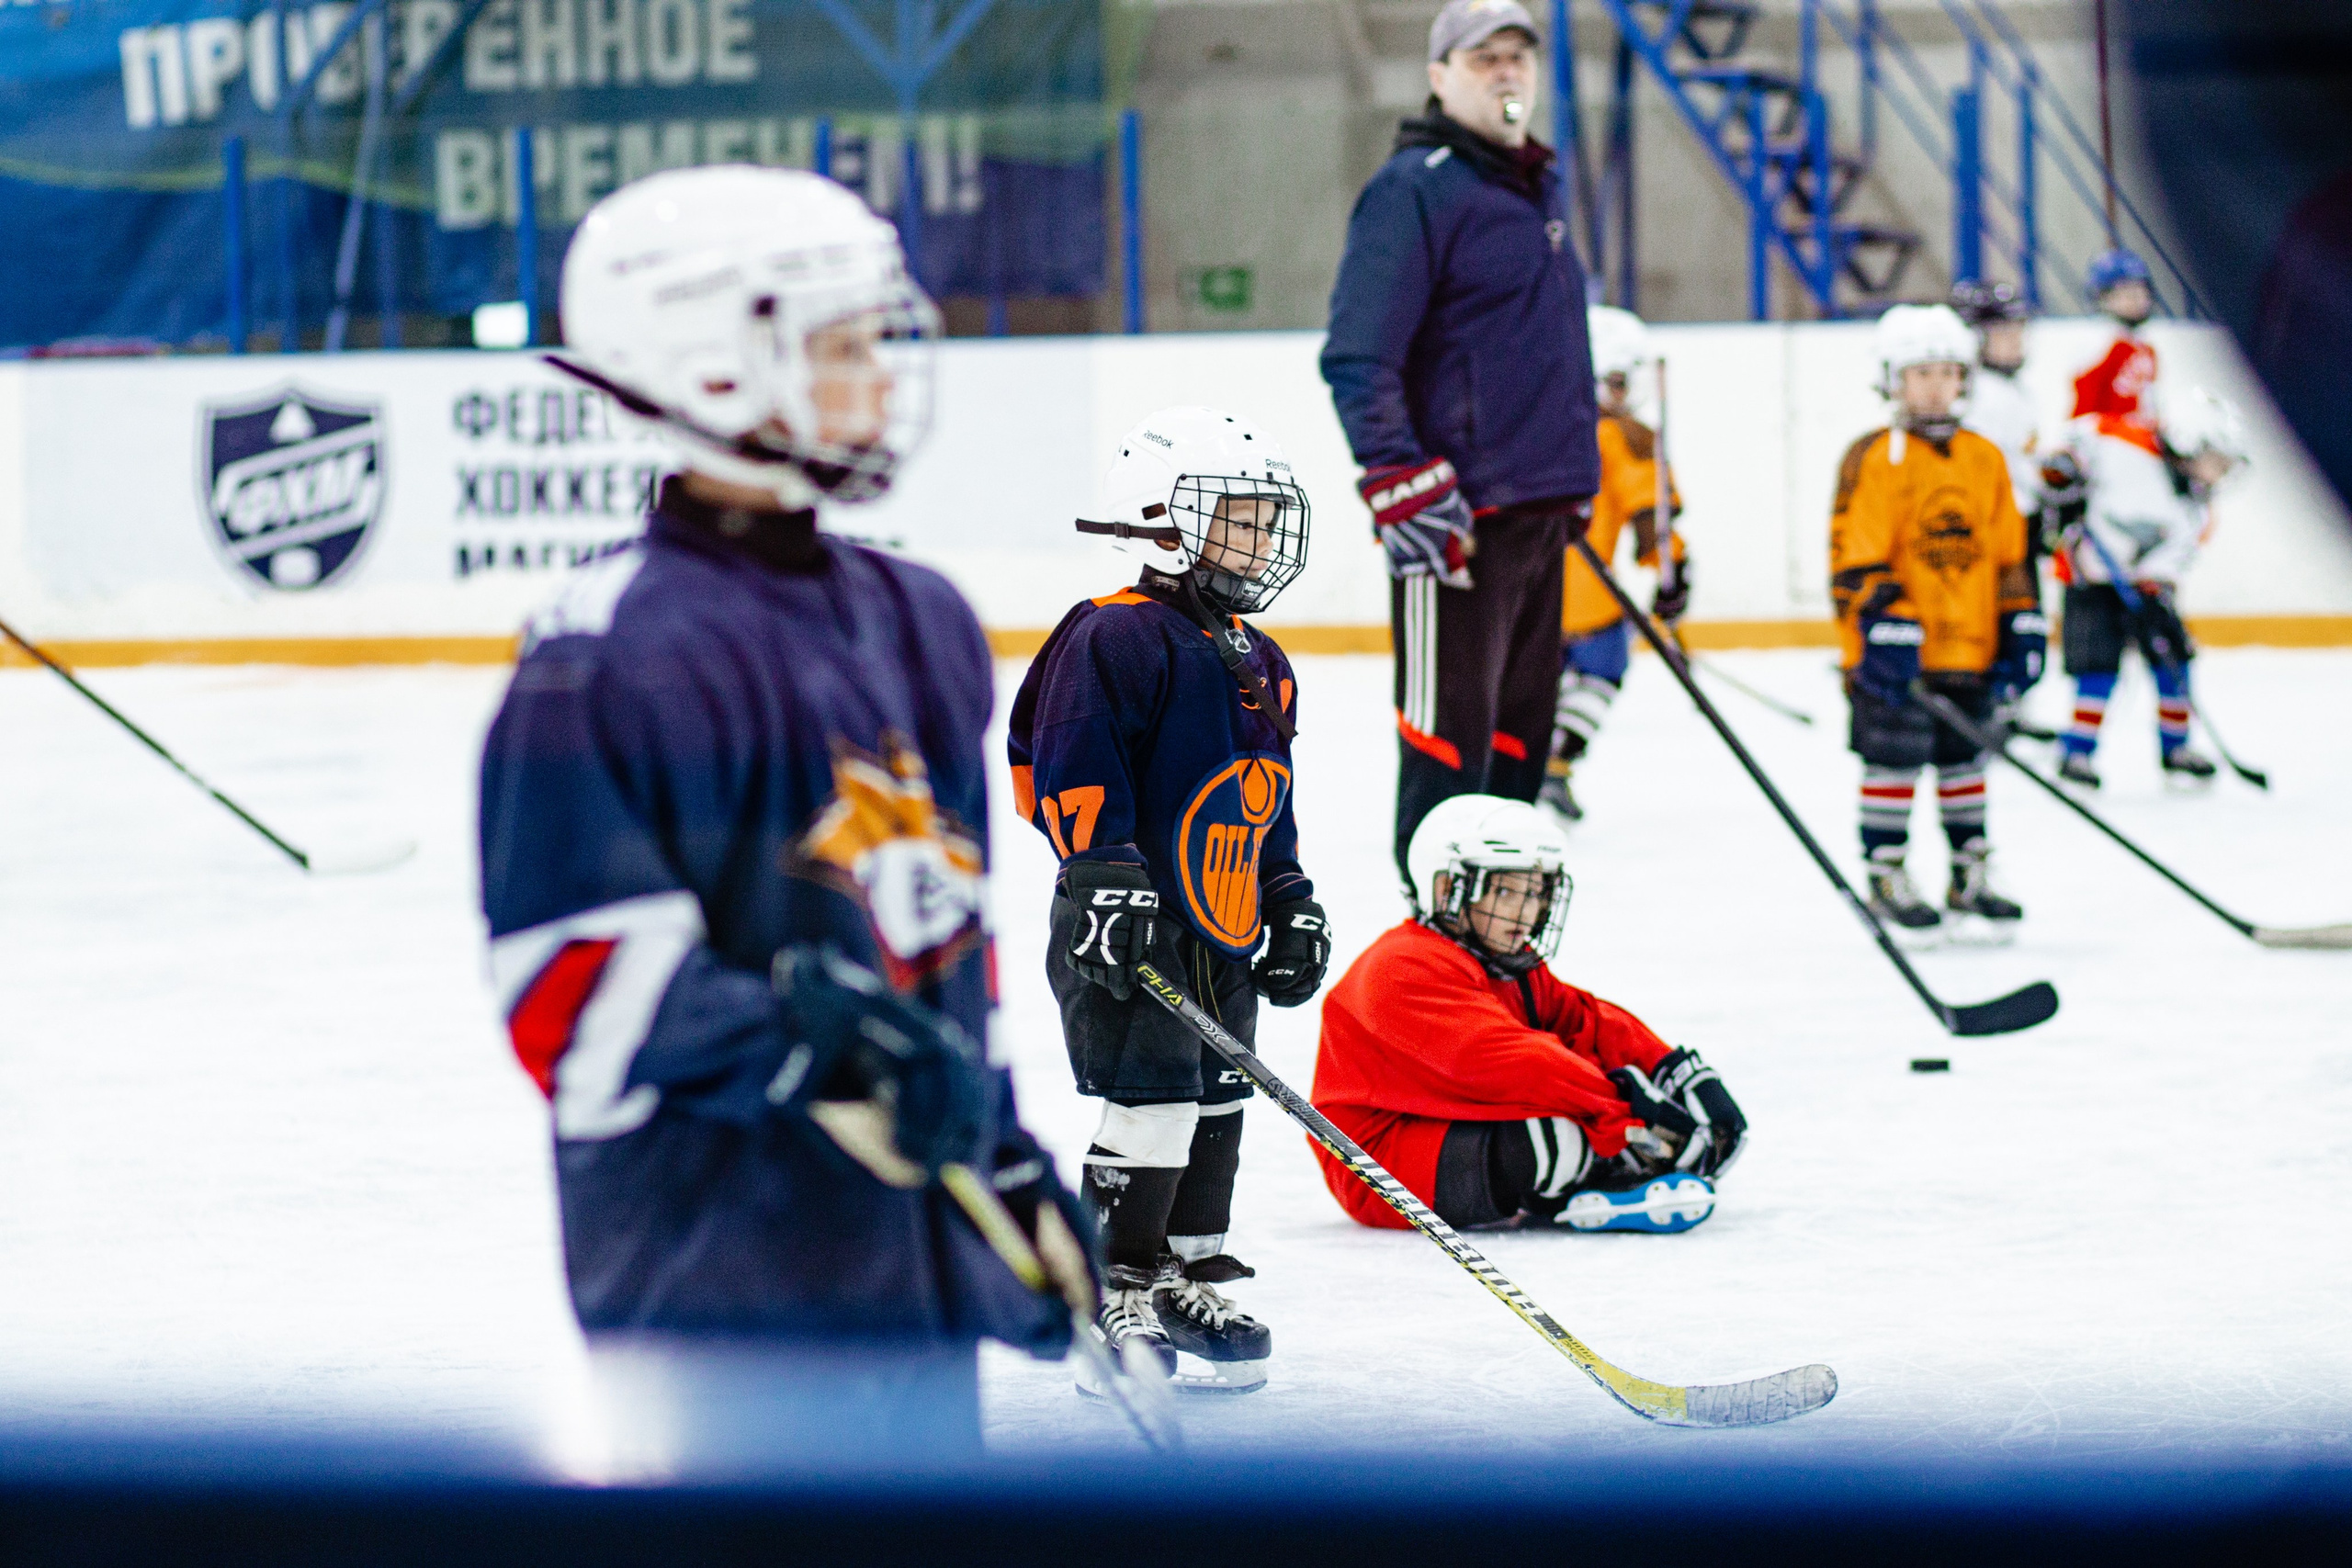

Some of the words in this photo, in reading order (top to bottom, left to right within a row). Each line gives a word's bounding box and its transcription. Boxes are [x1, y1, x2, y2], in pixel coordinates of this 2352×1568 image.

[1144, 430, 1174, 449] Reebok
[456, 461, 657, 515] ХОККЕЯ
[1267, 968, 1295, 976] CCM
